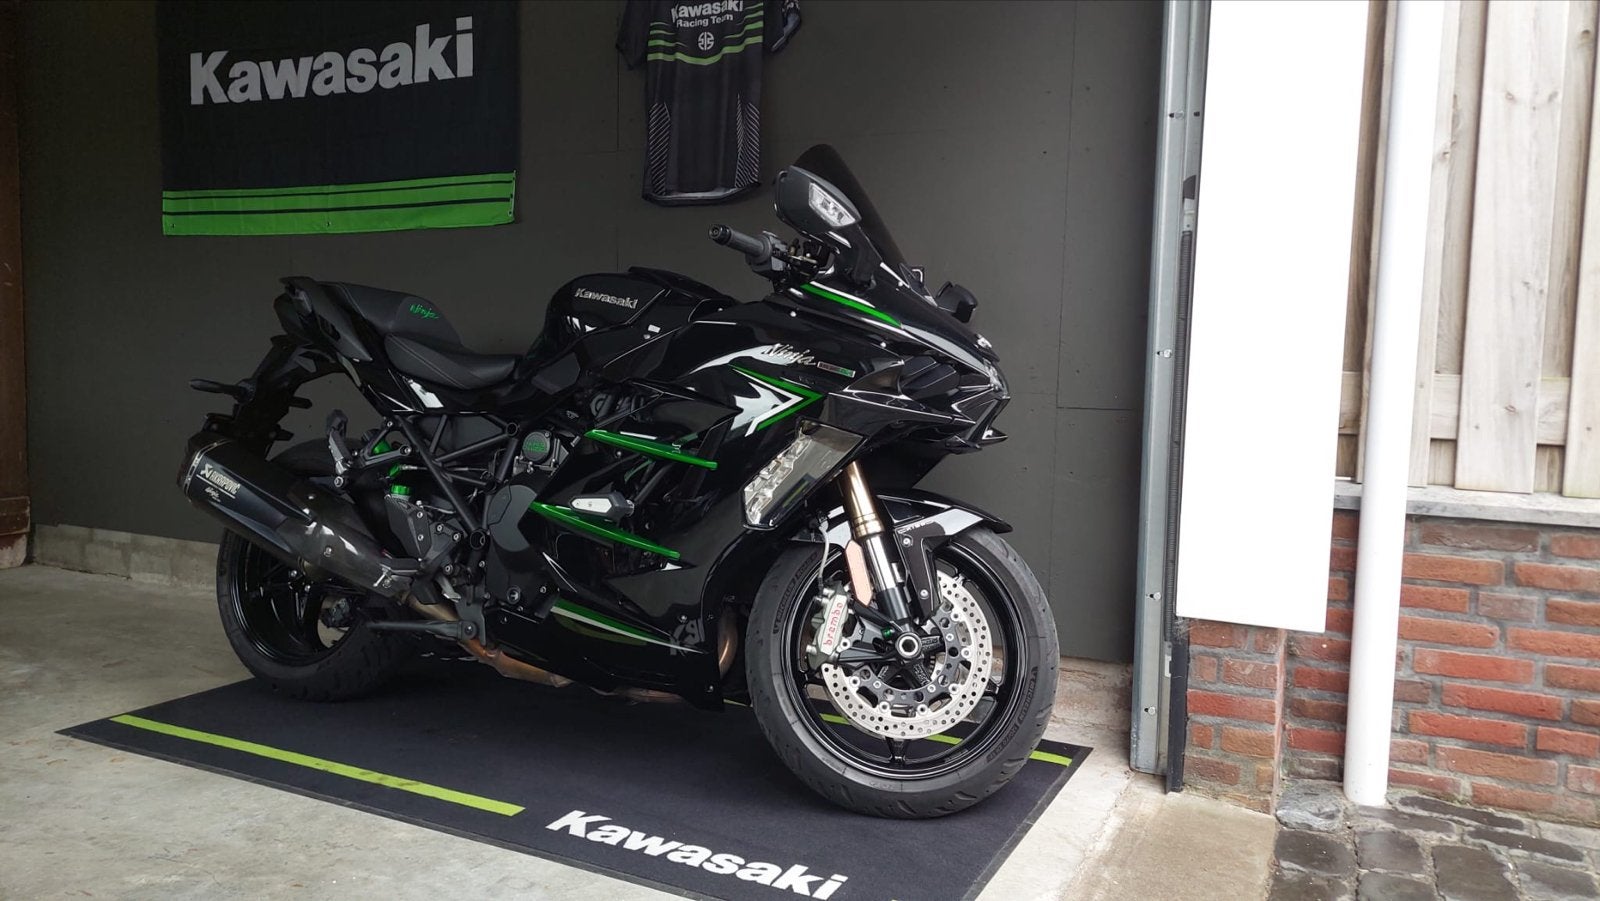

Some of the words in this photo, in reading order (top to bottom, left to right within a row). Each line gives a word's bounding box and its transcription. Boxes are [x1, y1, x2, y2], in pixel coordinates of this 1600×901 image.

[676, 18, 709, 28] Racing
[710, 13, 734, 24] Team
[190, 15, 474, 106] Kawasaki
[574, 287, 639, 309] Kawasaki
[823, 602, 844, 647] brembo
[545, 809, 849, 900] Kawasaki
